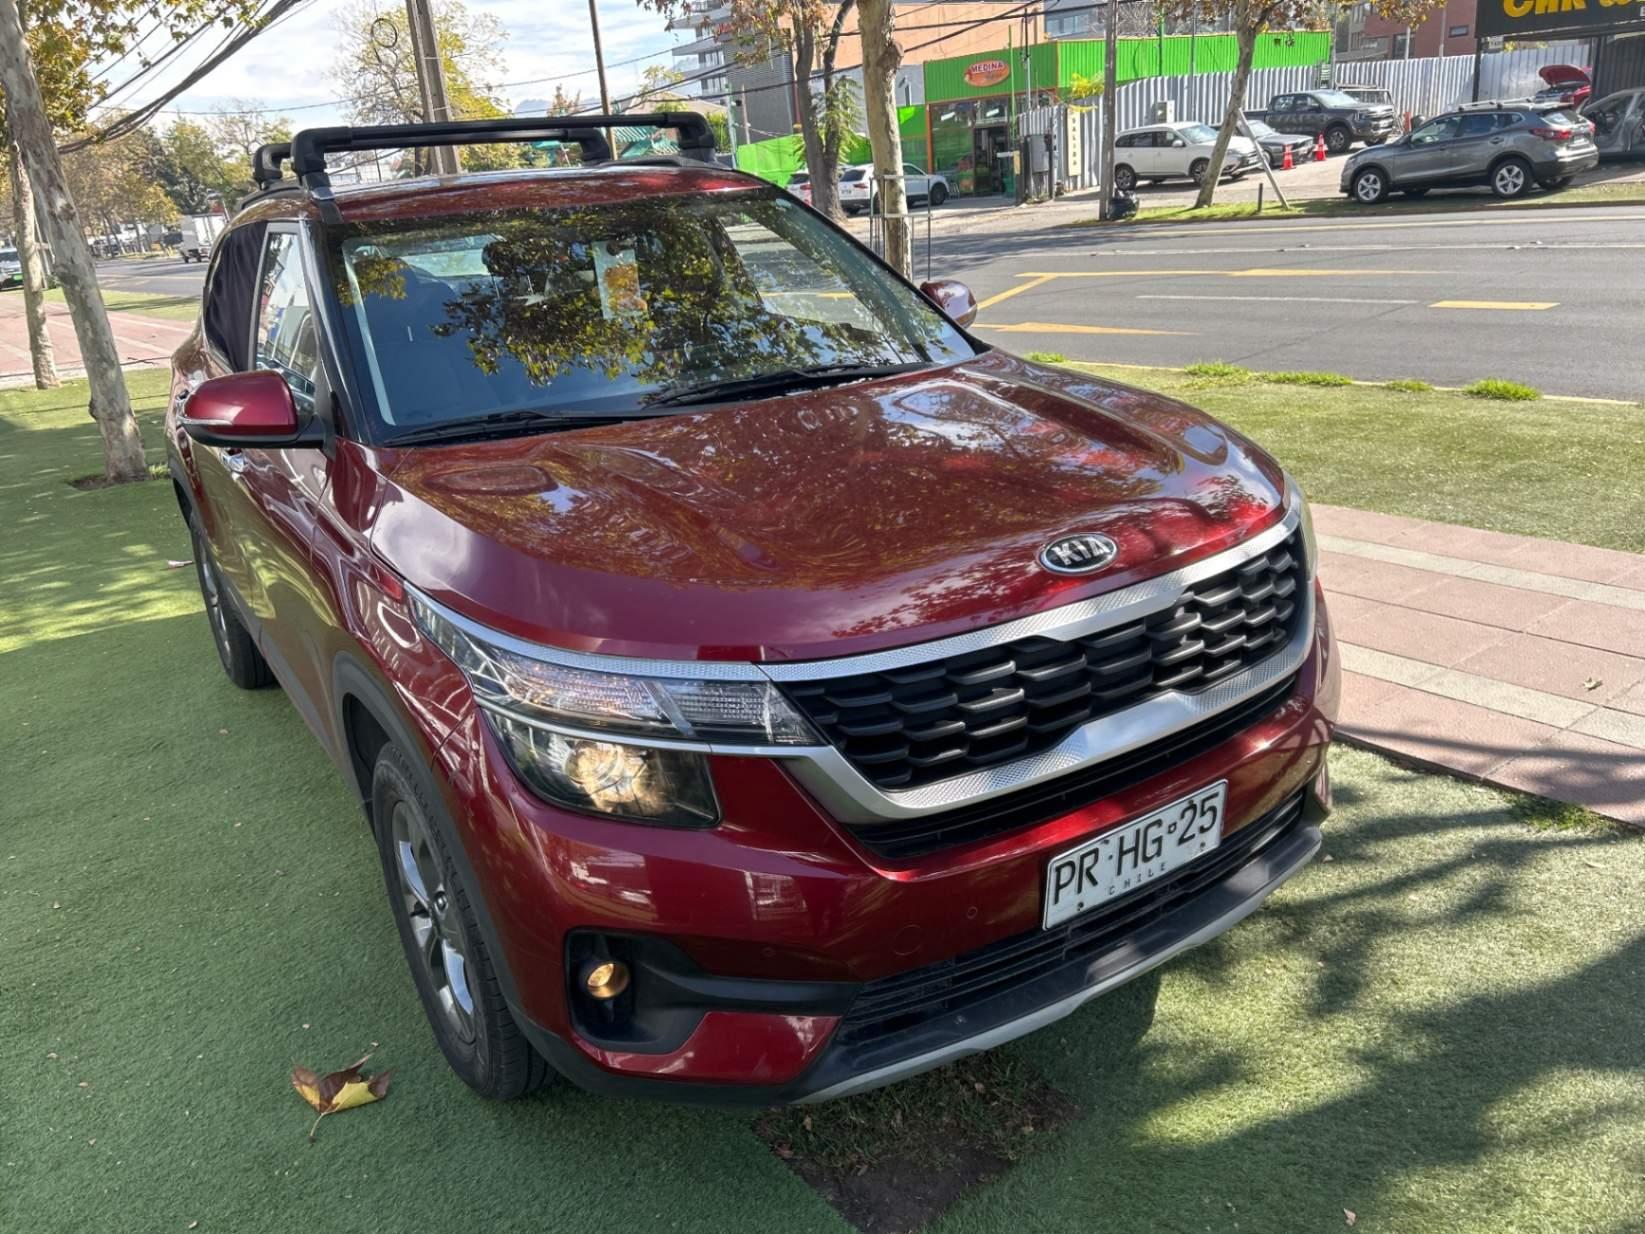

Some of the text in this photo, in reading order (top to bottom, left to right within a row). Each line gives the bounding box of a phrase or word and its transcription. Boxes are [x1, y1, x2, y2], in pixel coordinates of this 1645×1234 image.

[971, 61, 1003, 73] MEDINA
[1050, 536, 1111, 566] KIA
[1108, 861, 1167, 896] CHILE
